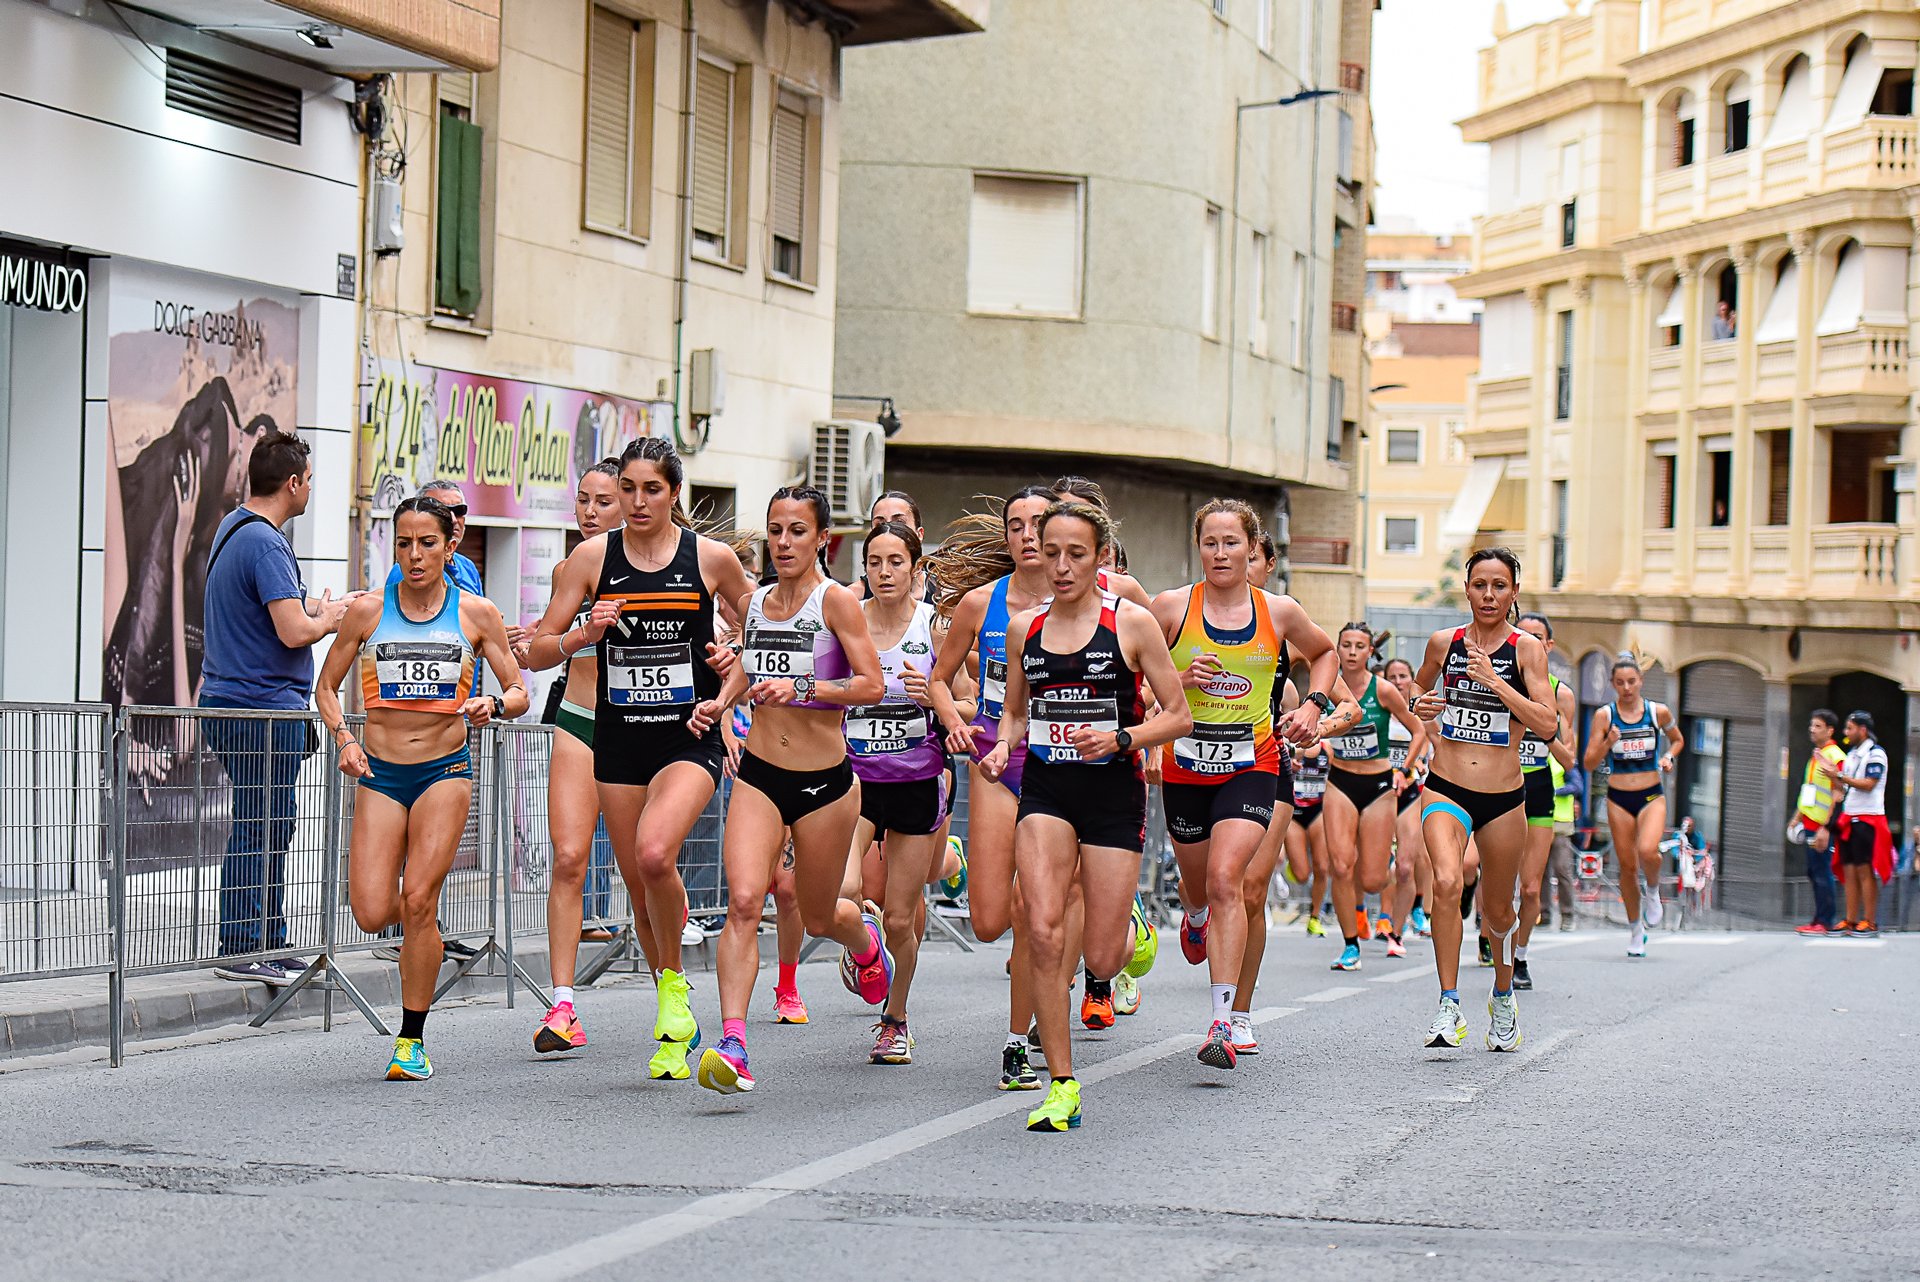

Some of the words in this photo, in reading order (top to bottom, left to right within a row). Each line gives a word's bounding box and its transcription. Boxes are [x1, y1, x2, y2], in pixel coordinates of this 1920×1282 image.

[154, 300, 195, 338] DOLCE
[202, 311, 262, 348] GABBANA
[436, 384, 473, 482] del
[430, 630, 460, 640] HOKA
[641, 621, 685, 631] VICKY
[646, 632, 679, 640] FOODS
[398, 661, 440, 681] 186
[755, 652, 790, 673] 168
[627, 667, 670, 688] 156
[868, 720, 907, 738] 155
[1456, 709, 1491, 729] 159
[1049, 723, 1092, 745] 86
[1341, 737, 1366, 750] 182
[1195, 741, 1233, 761] 173
